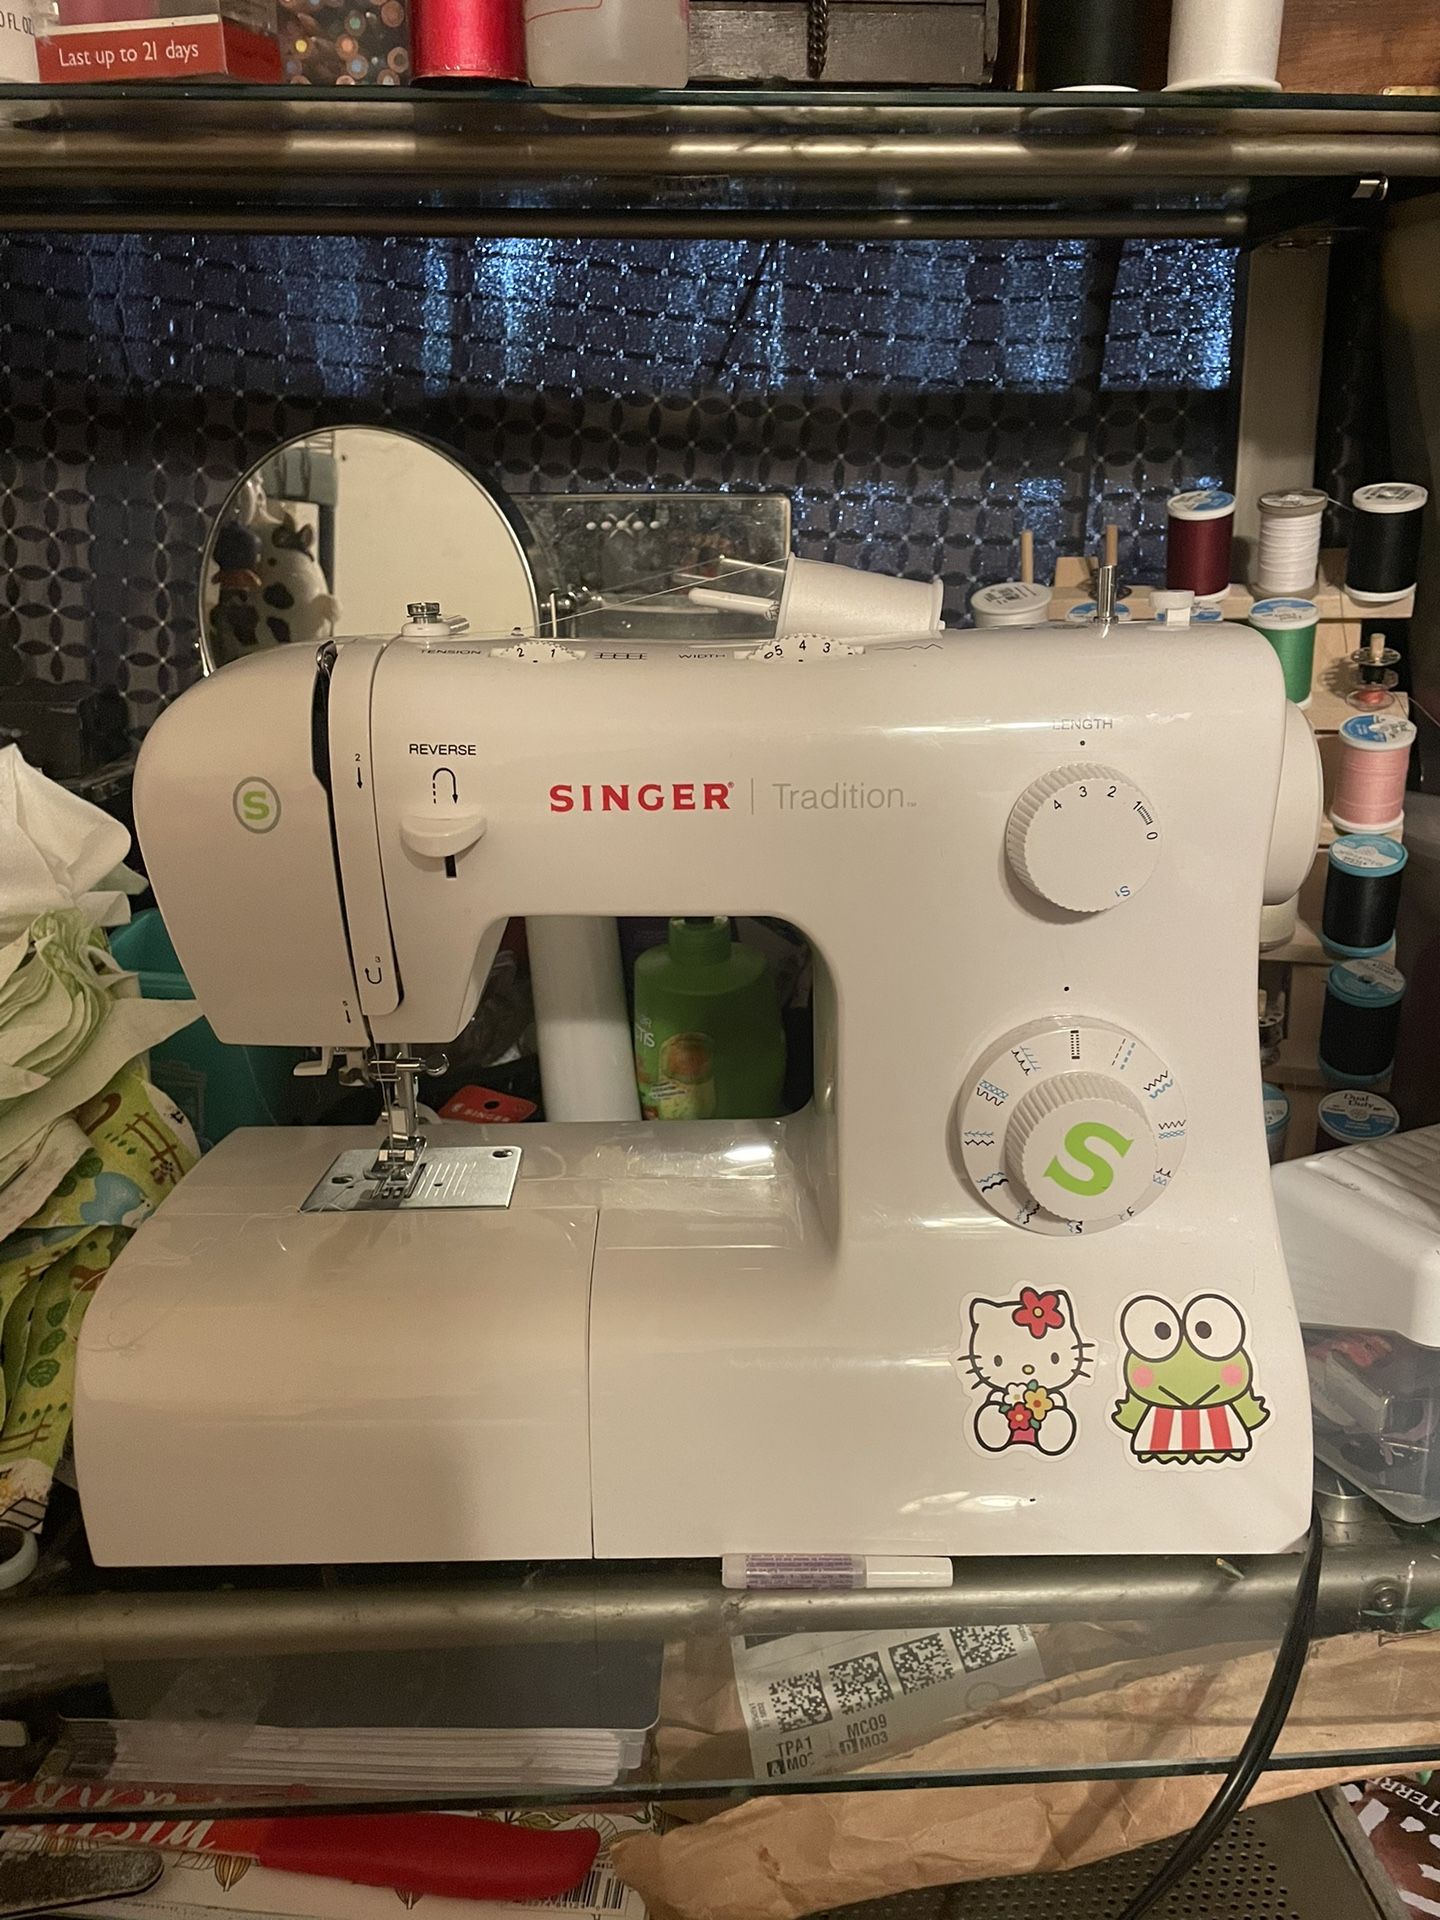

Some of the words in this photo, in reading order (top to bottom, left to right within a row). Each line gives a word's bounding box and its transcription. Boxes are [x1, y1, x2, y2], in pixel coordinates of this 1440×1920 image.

[7, 12, 22, 32] FL
[59, 48, 91, 67] Last
[96, 51, 115, 69] up
[120, 47, 137, 62] to
[142, 41, 157, 61] 21
[166, 40, 199, 63] days
[516, 647, 525, 657] 2
[550, 648, 556, 658] 1
[774, 644, 783, 656] 5
[798, 639, 807, 651] 4
[822, 642, 832, 653] 3
[1053, 718, 1113, 730] LENGTH
[409, 743, 477, 756] REVERSE
[1053, 799, 1063, 811] 4
[1078, 786, 1088, 798] 3
[1107, 785, 1117, 798] 2
[846, 1713, 888, 1739] MC09
[776, 1735, 812, 1757] TPA1
